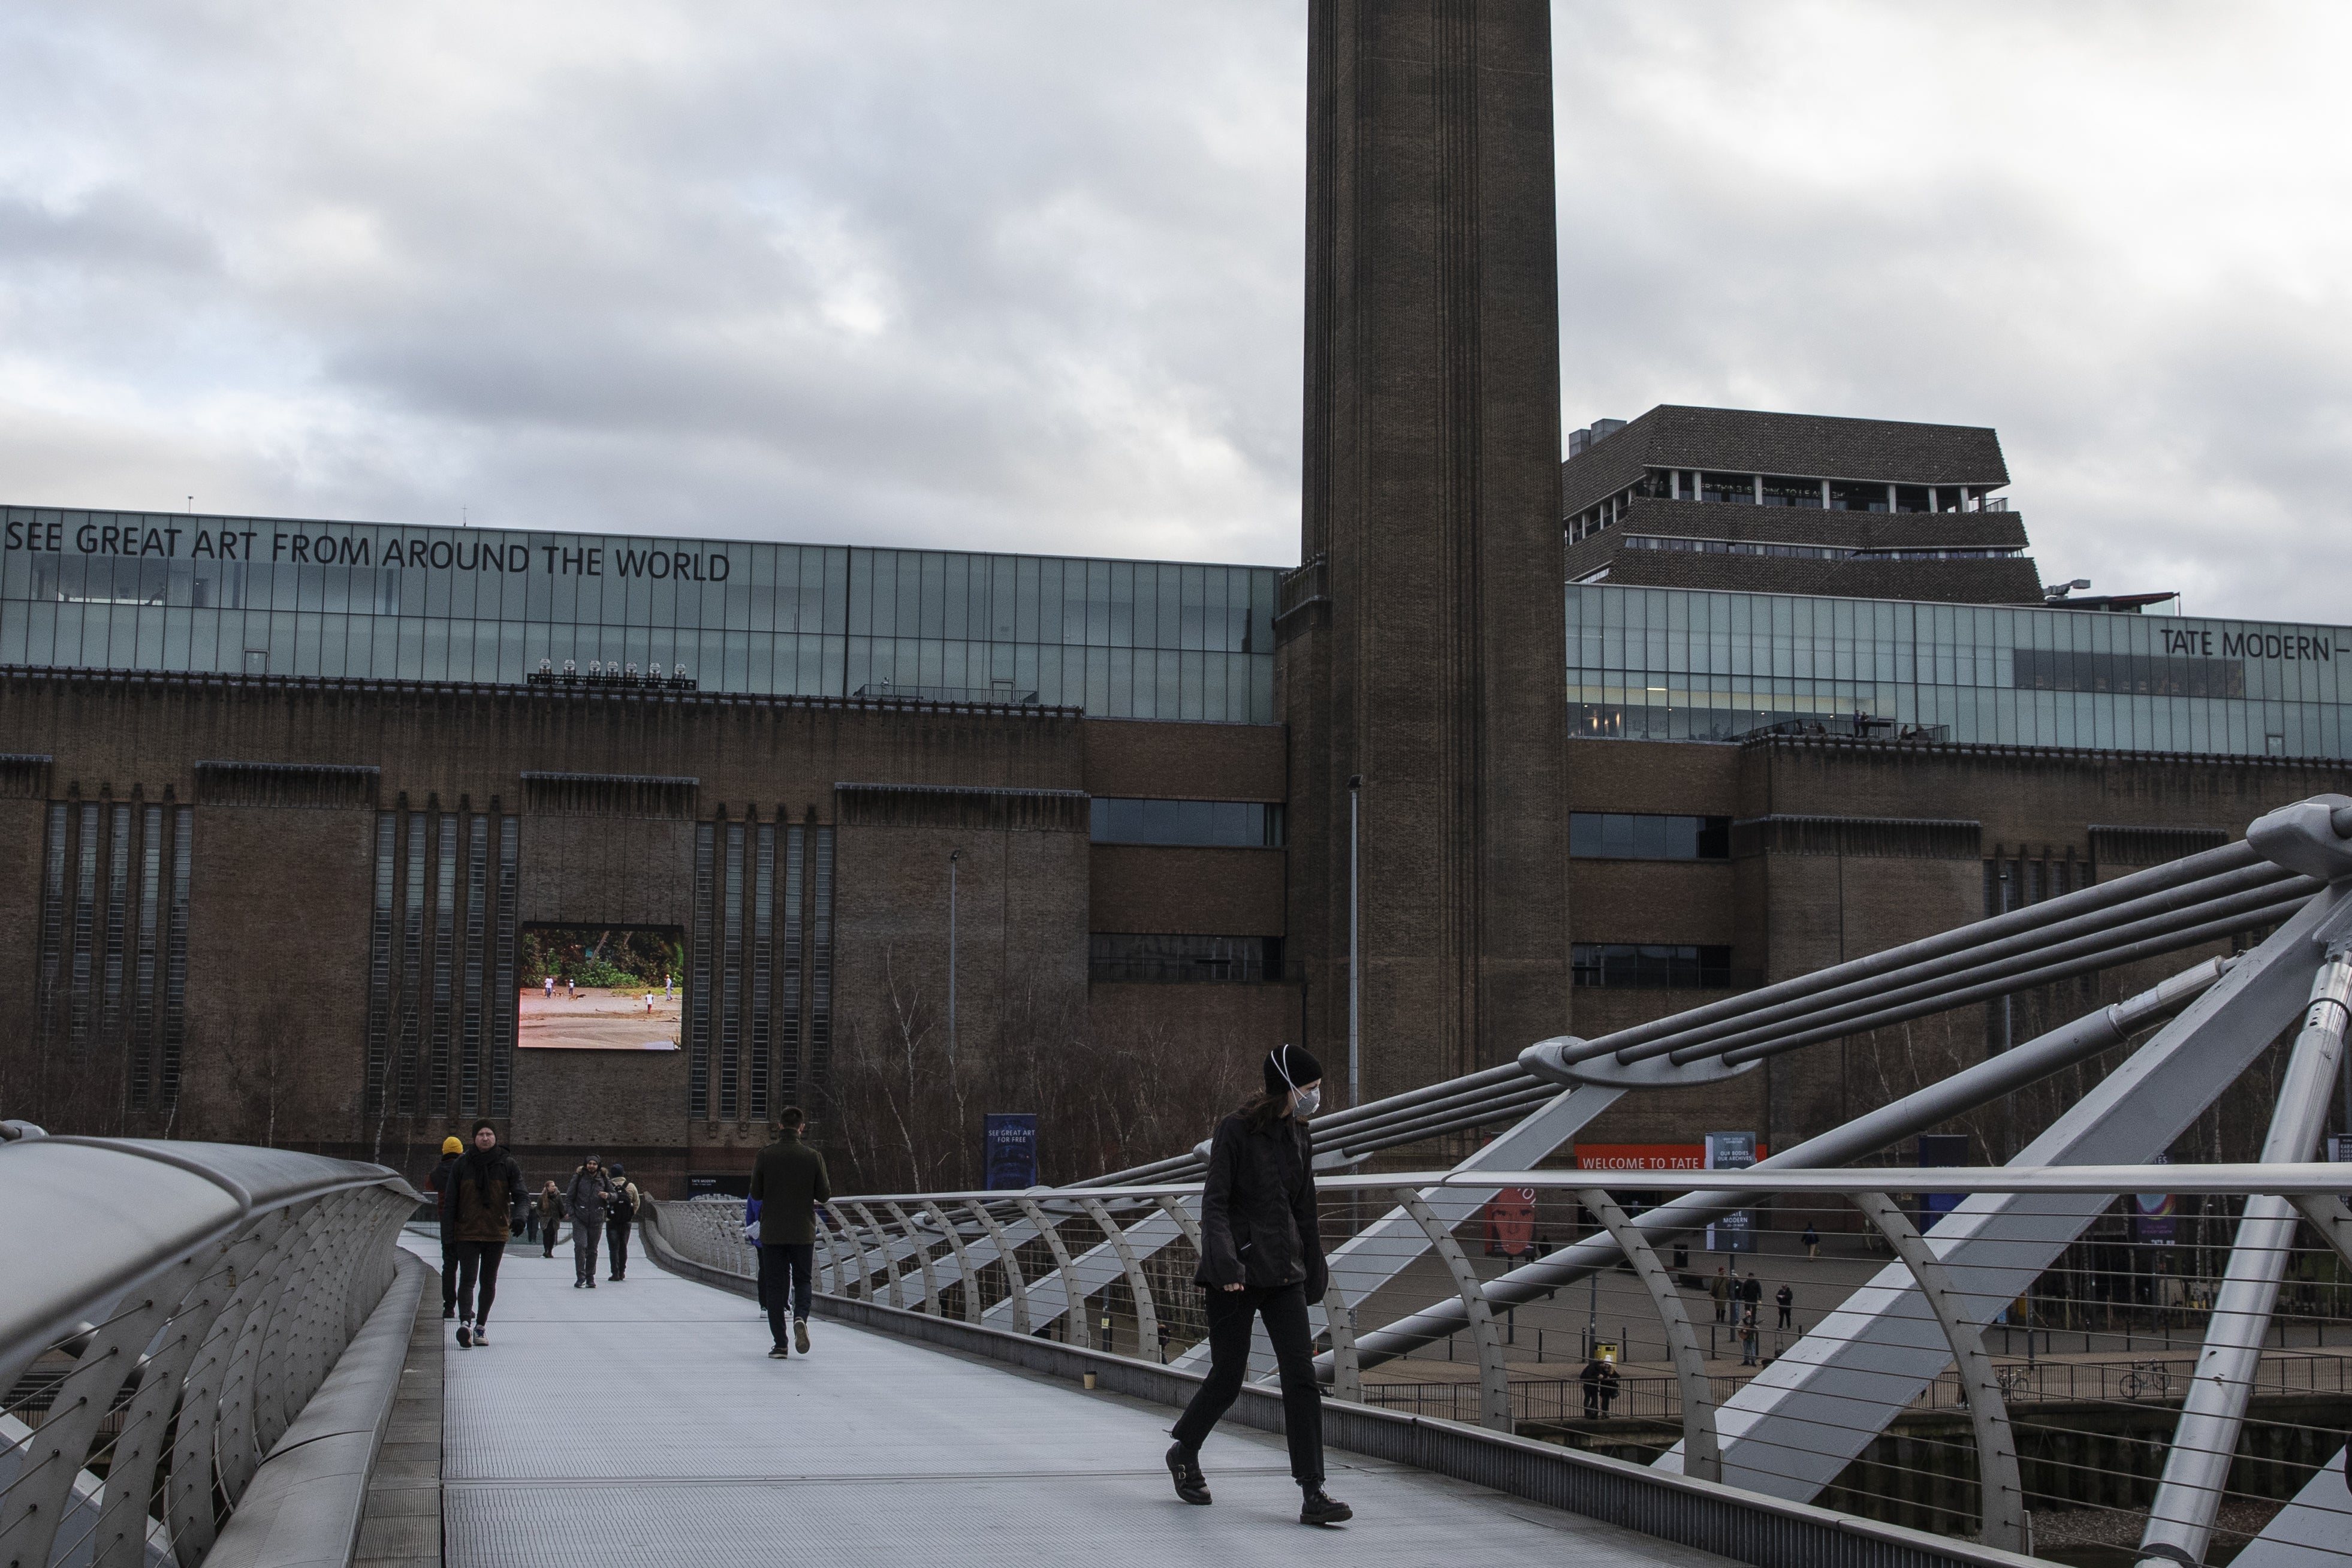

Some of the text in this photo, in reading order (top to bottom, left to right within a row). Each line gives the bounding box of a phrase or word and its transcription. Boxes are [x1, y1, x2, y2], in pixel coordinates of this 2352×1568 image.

[5, 521, 730, 582] SEE GREAT ART FROM AROUND THE WORLD
[2160, 629, 2213, 656] TATE
[2223, 632, 2330, 662] MODERN
[1582, 1157, 1645, 1169] WELCOME
[1651, 1157, 1666, 1169] TO
[1670, 1157, 1699, 1169] TATE
